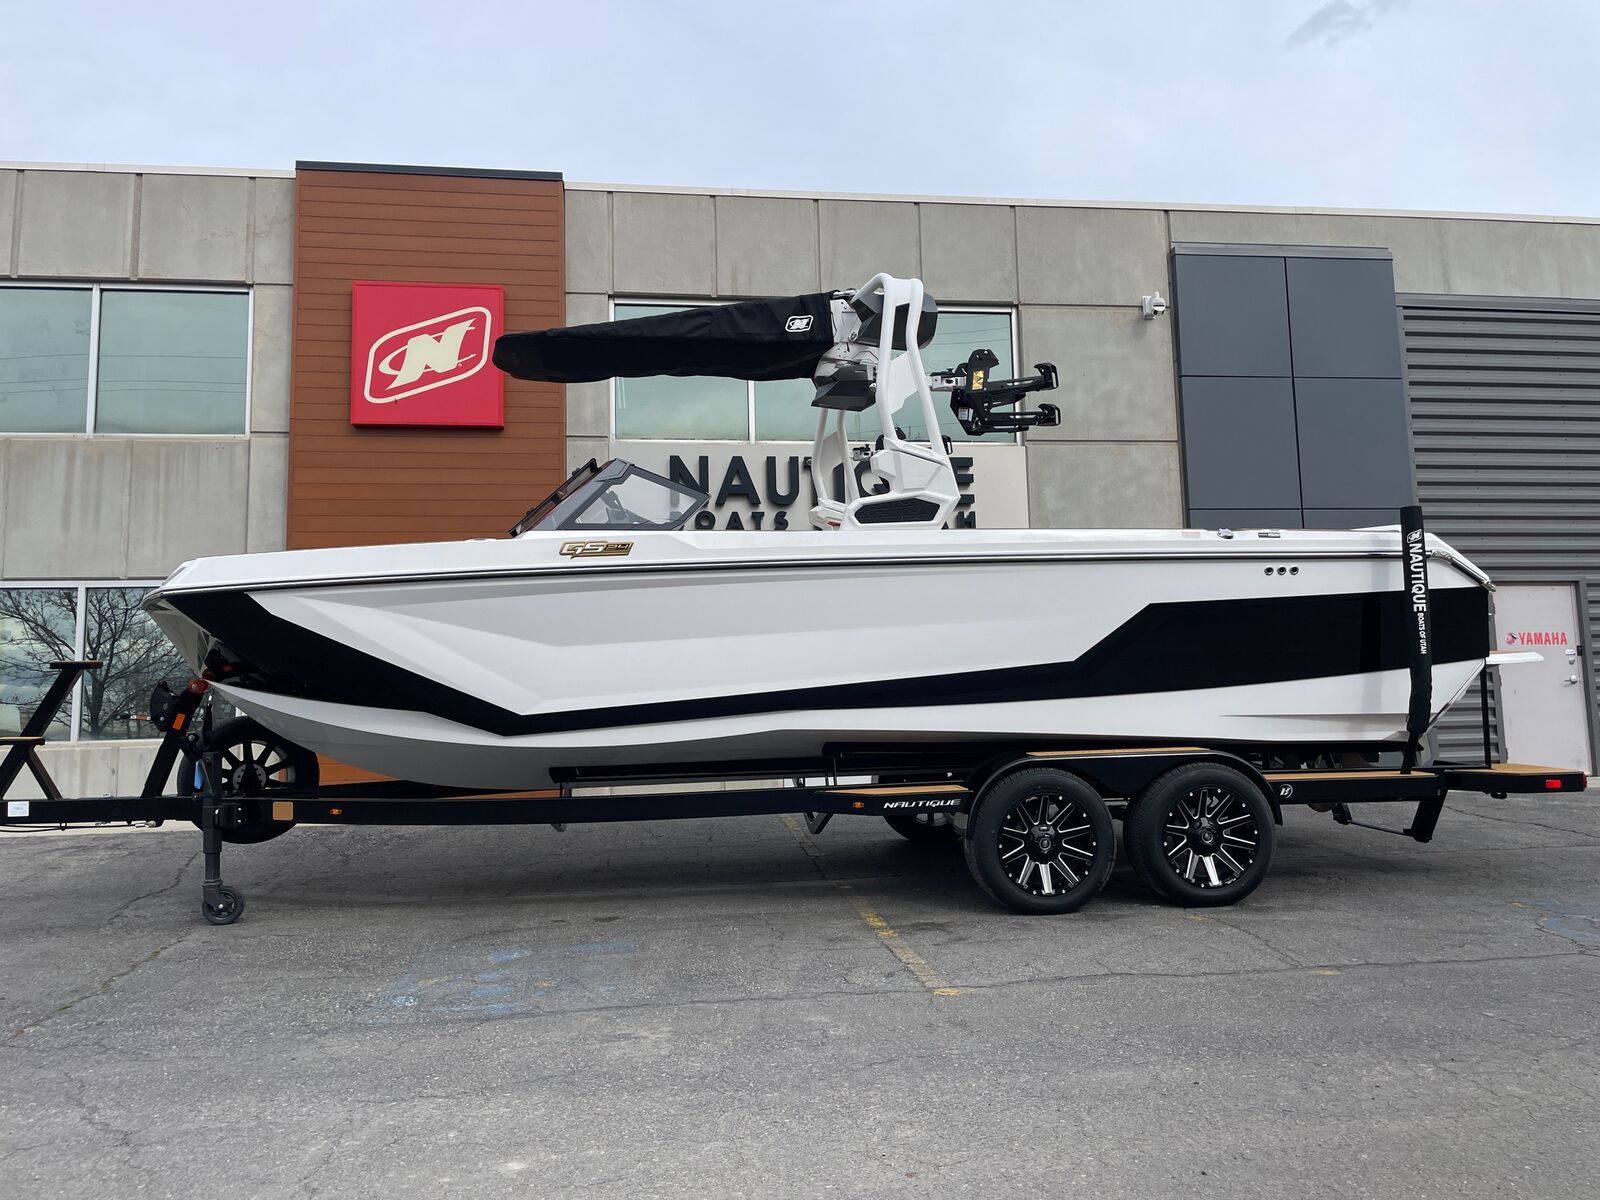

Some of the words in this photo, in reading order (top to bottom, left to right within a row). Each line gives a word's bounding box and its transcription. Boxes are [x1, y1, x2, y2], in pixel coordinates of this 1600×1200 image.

[669, 455, 975, 505] NAUIQE
[1408, 543, 1427, 612] NAUTIQUE
[1417, 612, 1426, 630] BOATS
[1419, 630, 1426, 639] OF
[1518, 632, 1568, 645] YAMAHA
[883, 799, 962, 809] NAUTIQUE
